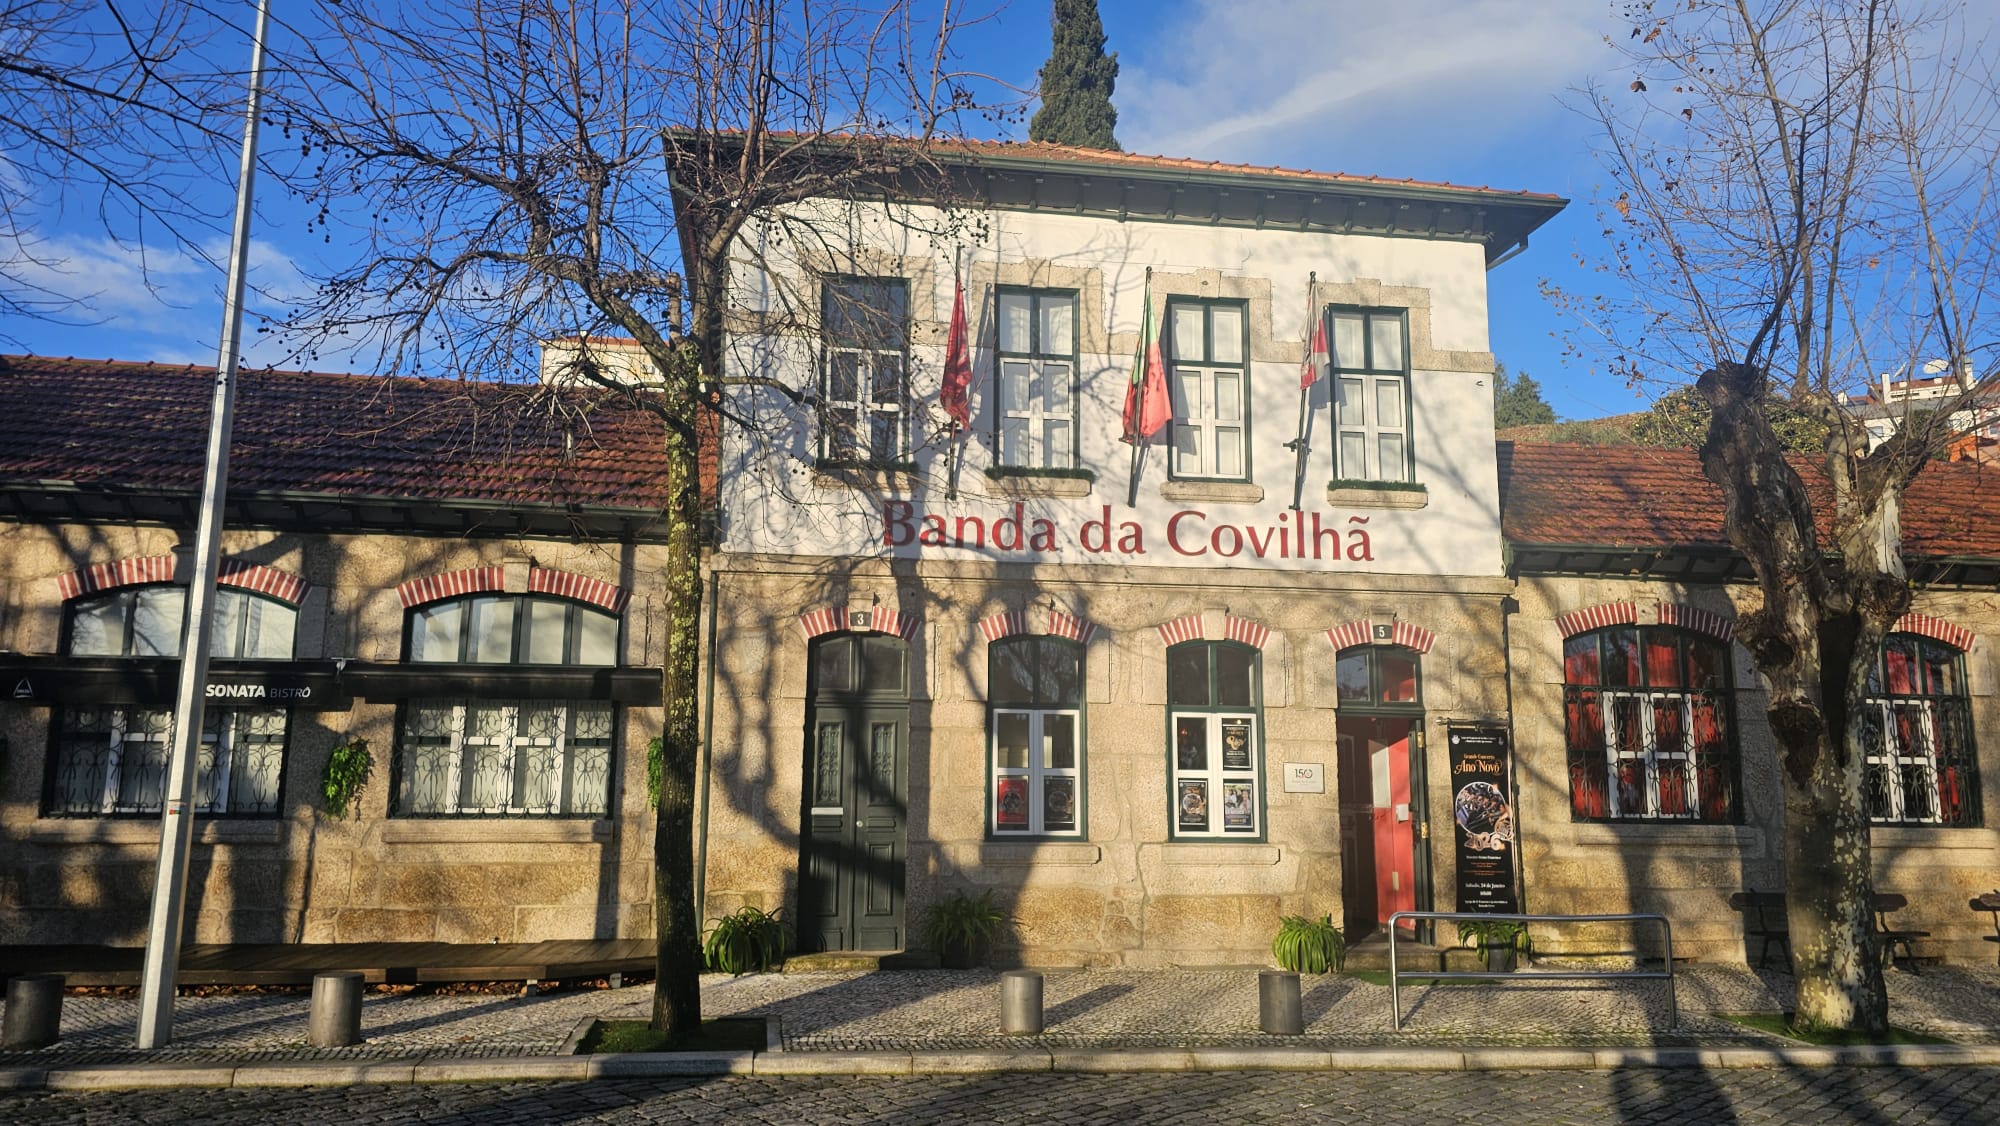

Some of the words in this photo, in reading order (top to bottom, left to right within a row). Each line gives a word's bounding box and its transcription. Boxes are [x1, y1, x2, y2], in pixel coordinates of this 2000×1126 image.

[883, 500, 1057, 553] Banda
[1080, 504, 1146, 555] da
[1167, 509, 1375, 562] Covilhã
[857, 613, 864, 625] 3
[1378, 626, 1386, 638] 5
[205, 684, 266, 698] SONATA
[270, 686, 311, 698] BISTRÔ
[1294, 768, 1313, 779] 150
[1455, 760, 1476, 774] Ano
